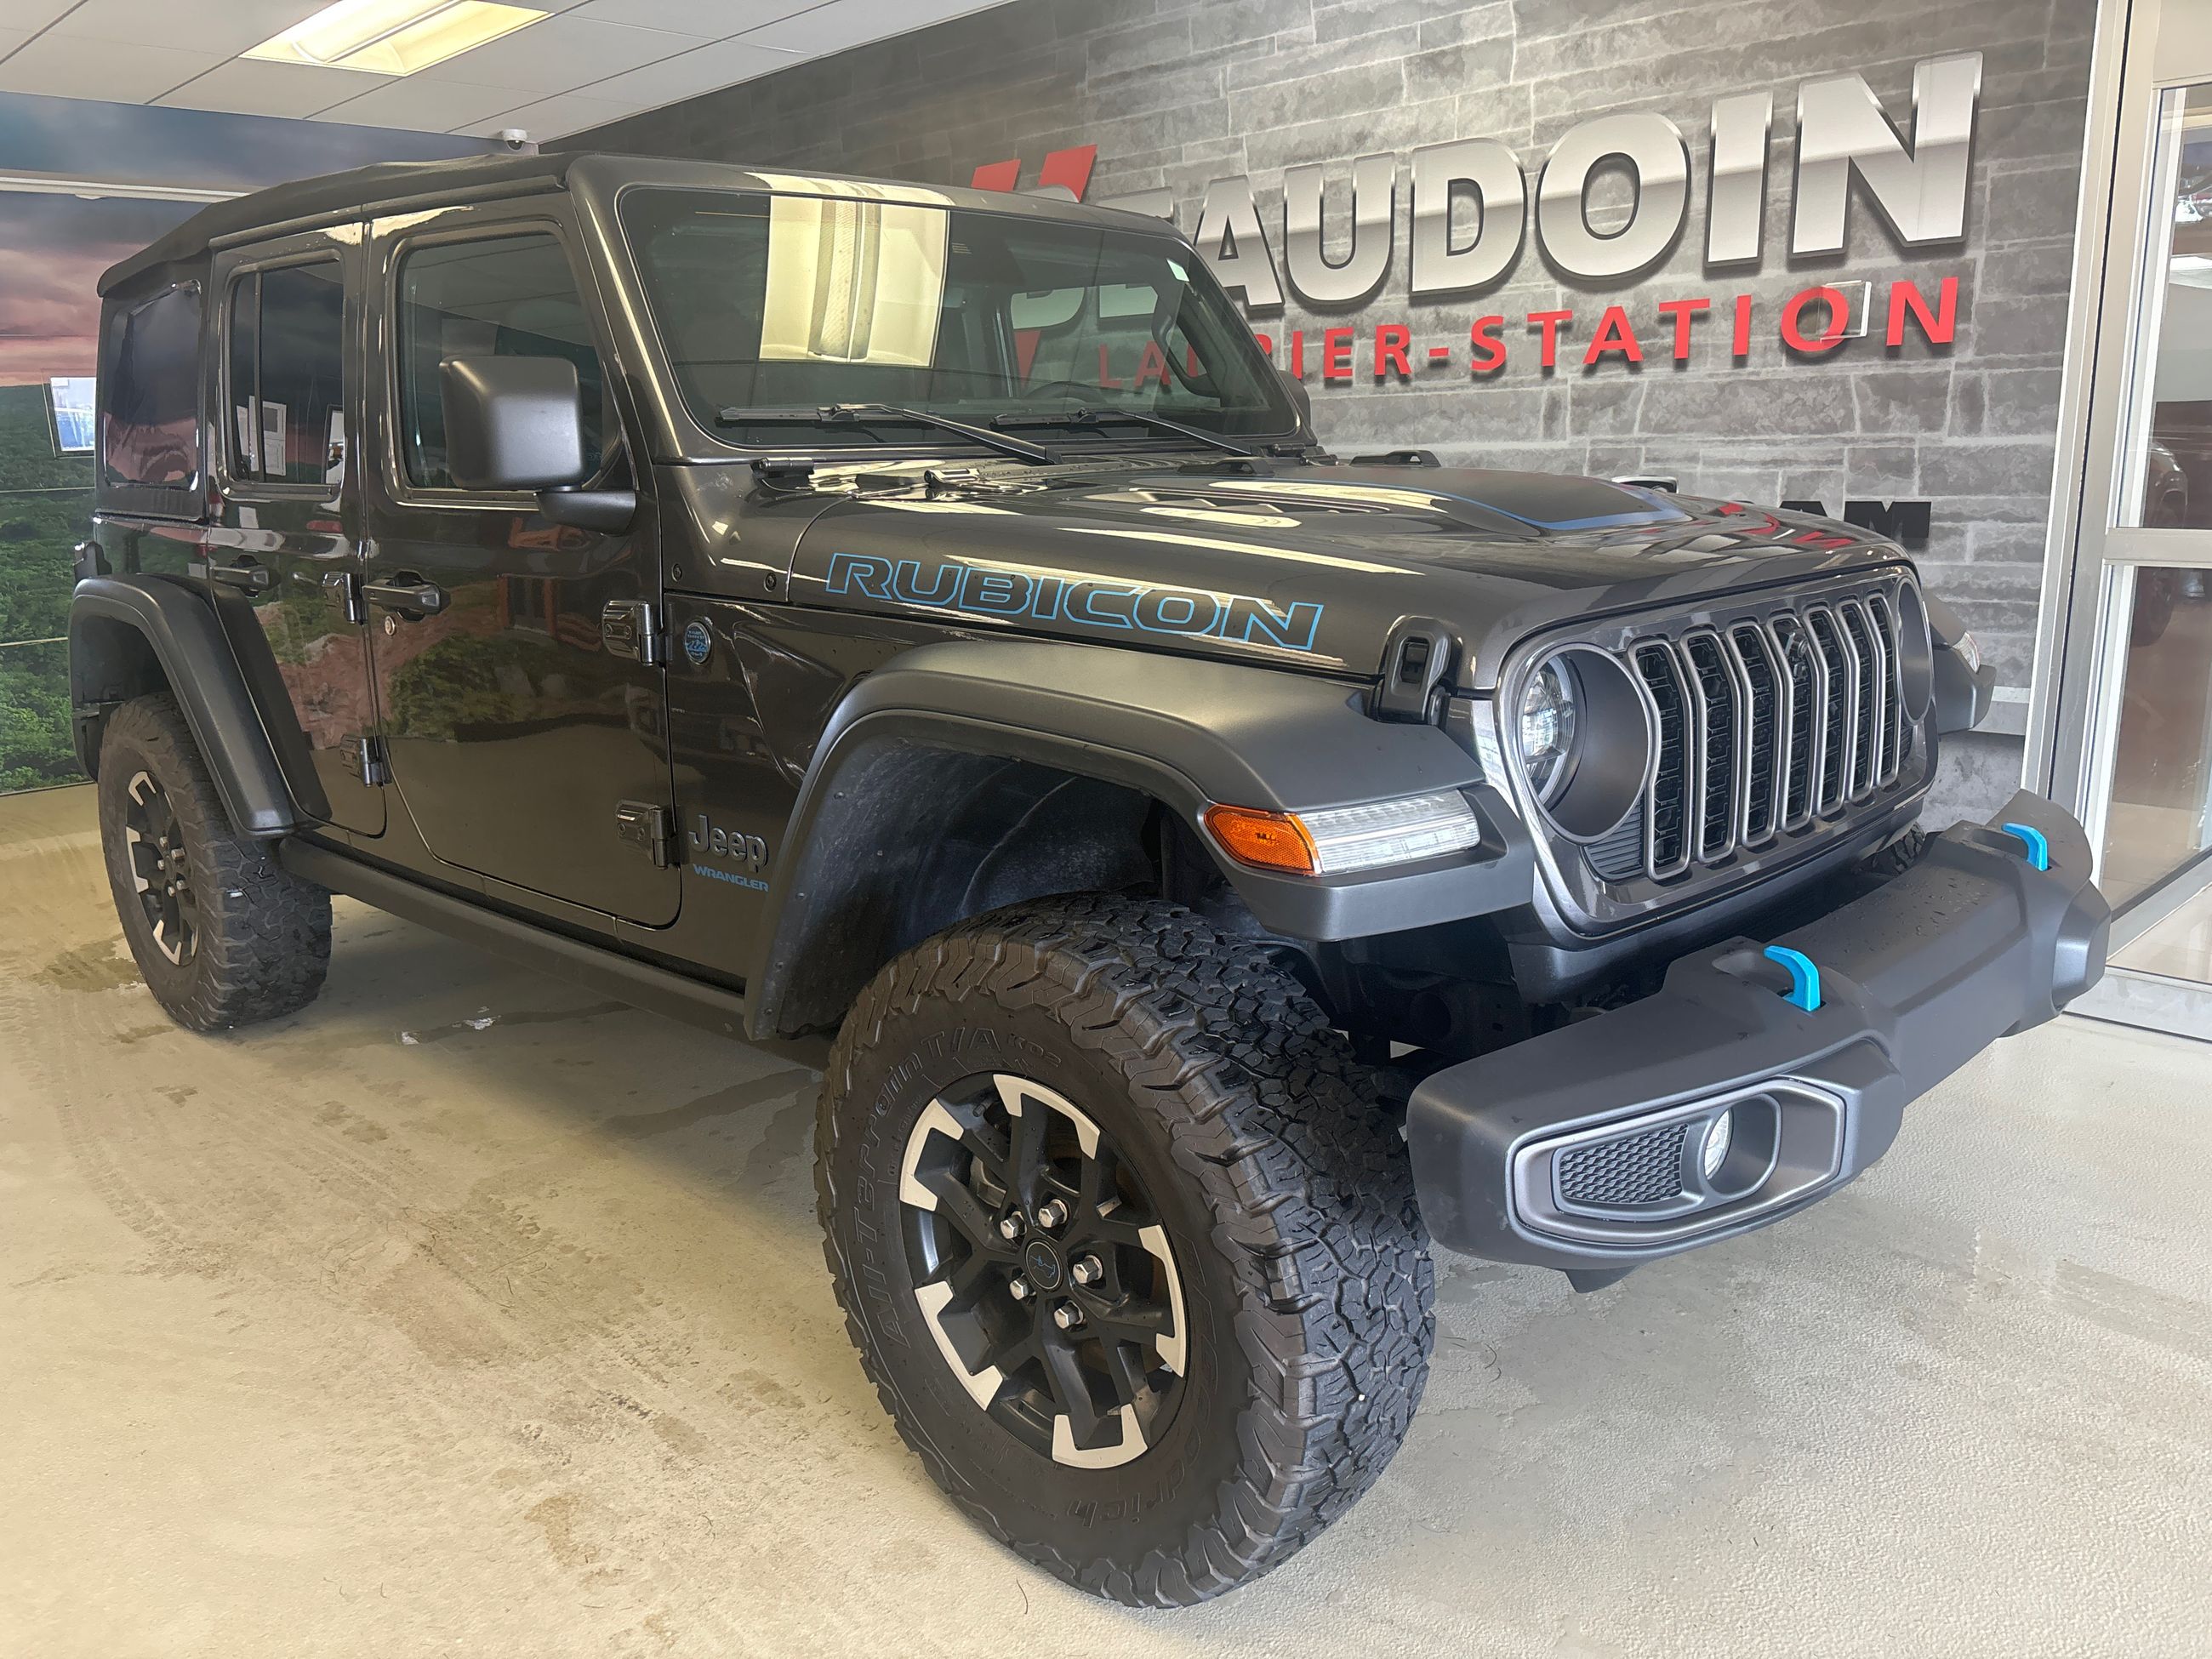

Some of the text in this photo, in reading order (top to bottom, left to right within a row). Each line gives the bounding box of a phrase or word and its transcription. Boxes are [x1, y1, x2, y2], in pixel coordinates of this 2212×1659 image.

[826, 552, 1324, 650] RUBICON
[687, 814, 768, 873] Jeep
[693, 863, 769, 892] WRANGLER
